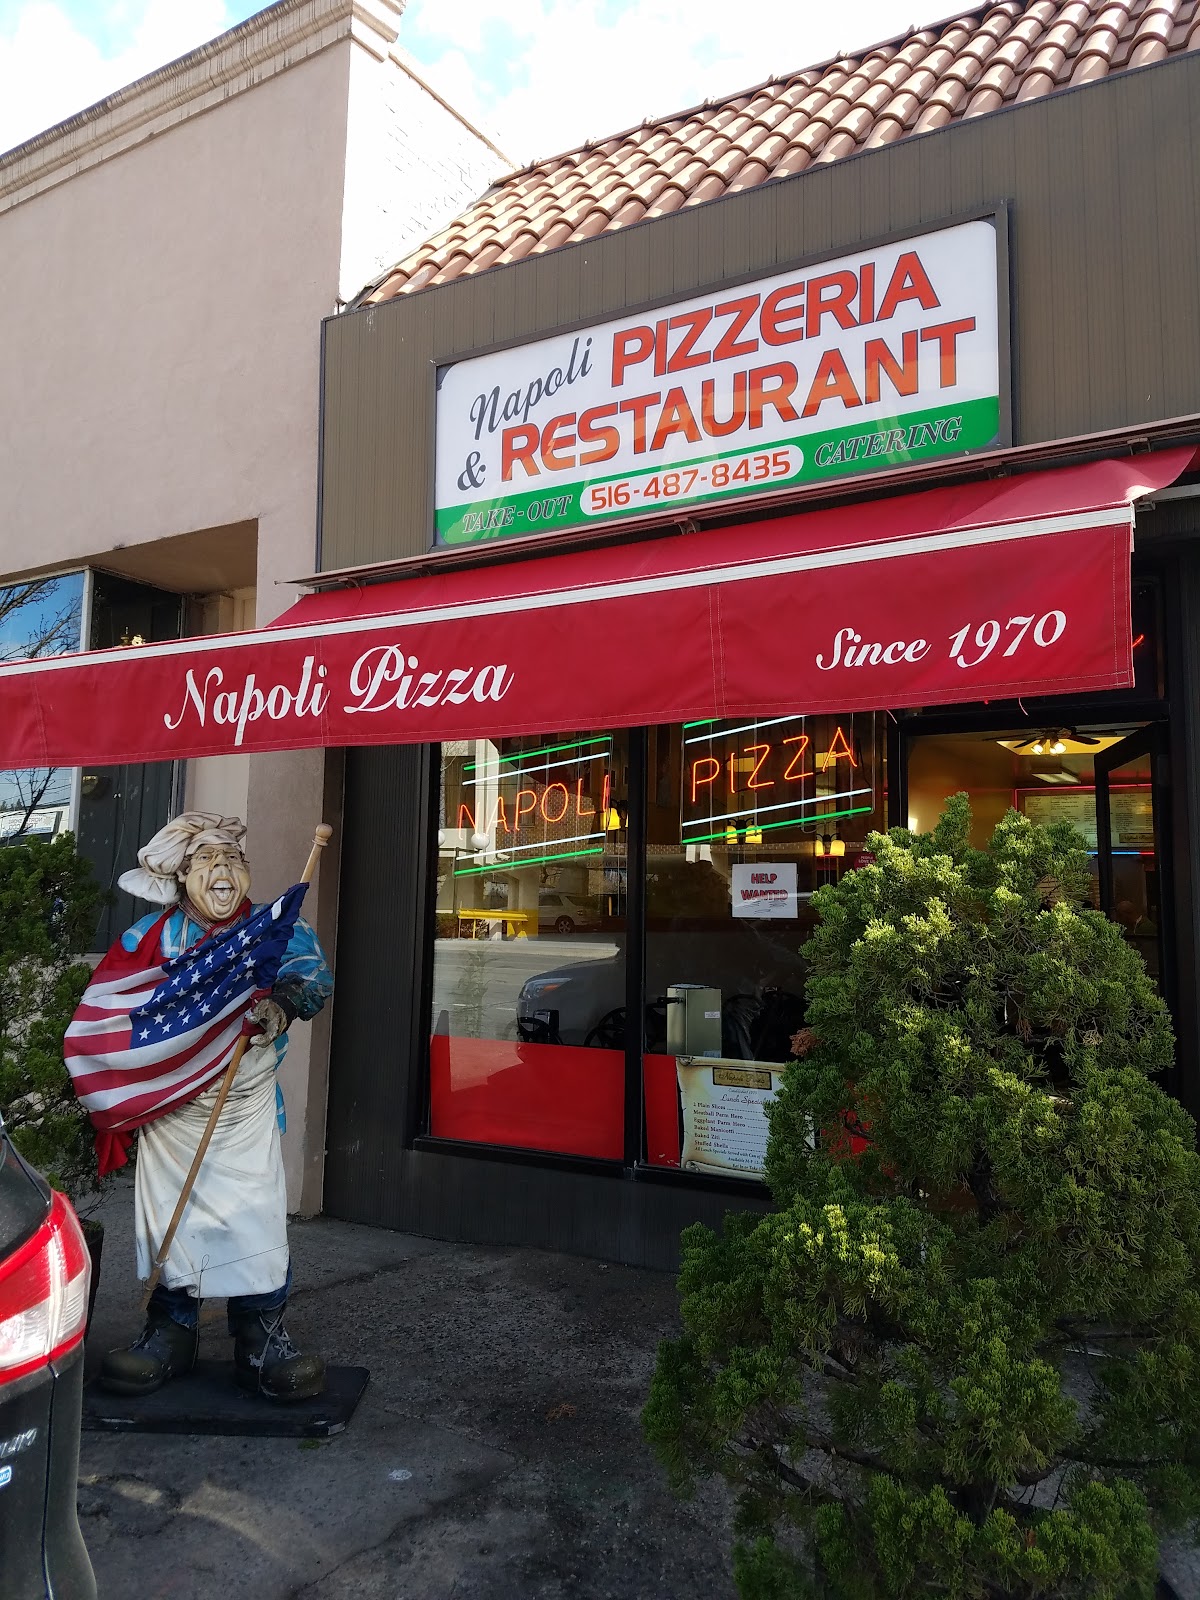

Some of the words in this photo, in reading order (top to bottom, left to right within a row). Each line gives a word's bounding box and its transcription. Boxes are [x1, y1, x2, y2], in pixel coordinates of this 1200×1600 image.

[470, 337, 592, 441] Napoli
[611, 251, 941, 388] PIZZERIA
[457, 450, 486, 492] &
[501, 316, 976, 482] RESTAURANT
[590, 450, 791, 512] 516-487-8435
[814, 416, 962, 468] CATERING
[816, 628, 932, 670] Since
[948, 610, 1067, 668] 1970
[164, 655, 330, 746] Napoli
[343, 643, 515, 713] Pizza
[691, 727, 858, 803] PIZZA
[458, 774, 611, 840] NAPOLI
[740, 889, 788, 901] WANTED
[751, 873, 777, 884] HELP
[693, 1117, 715, 1125] Eggplant
[720, 1093, 740, 1103] Lunch
[710, 1126, 735, 1134] Manicotti
